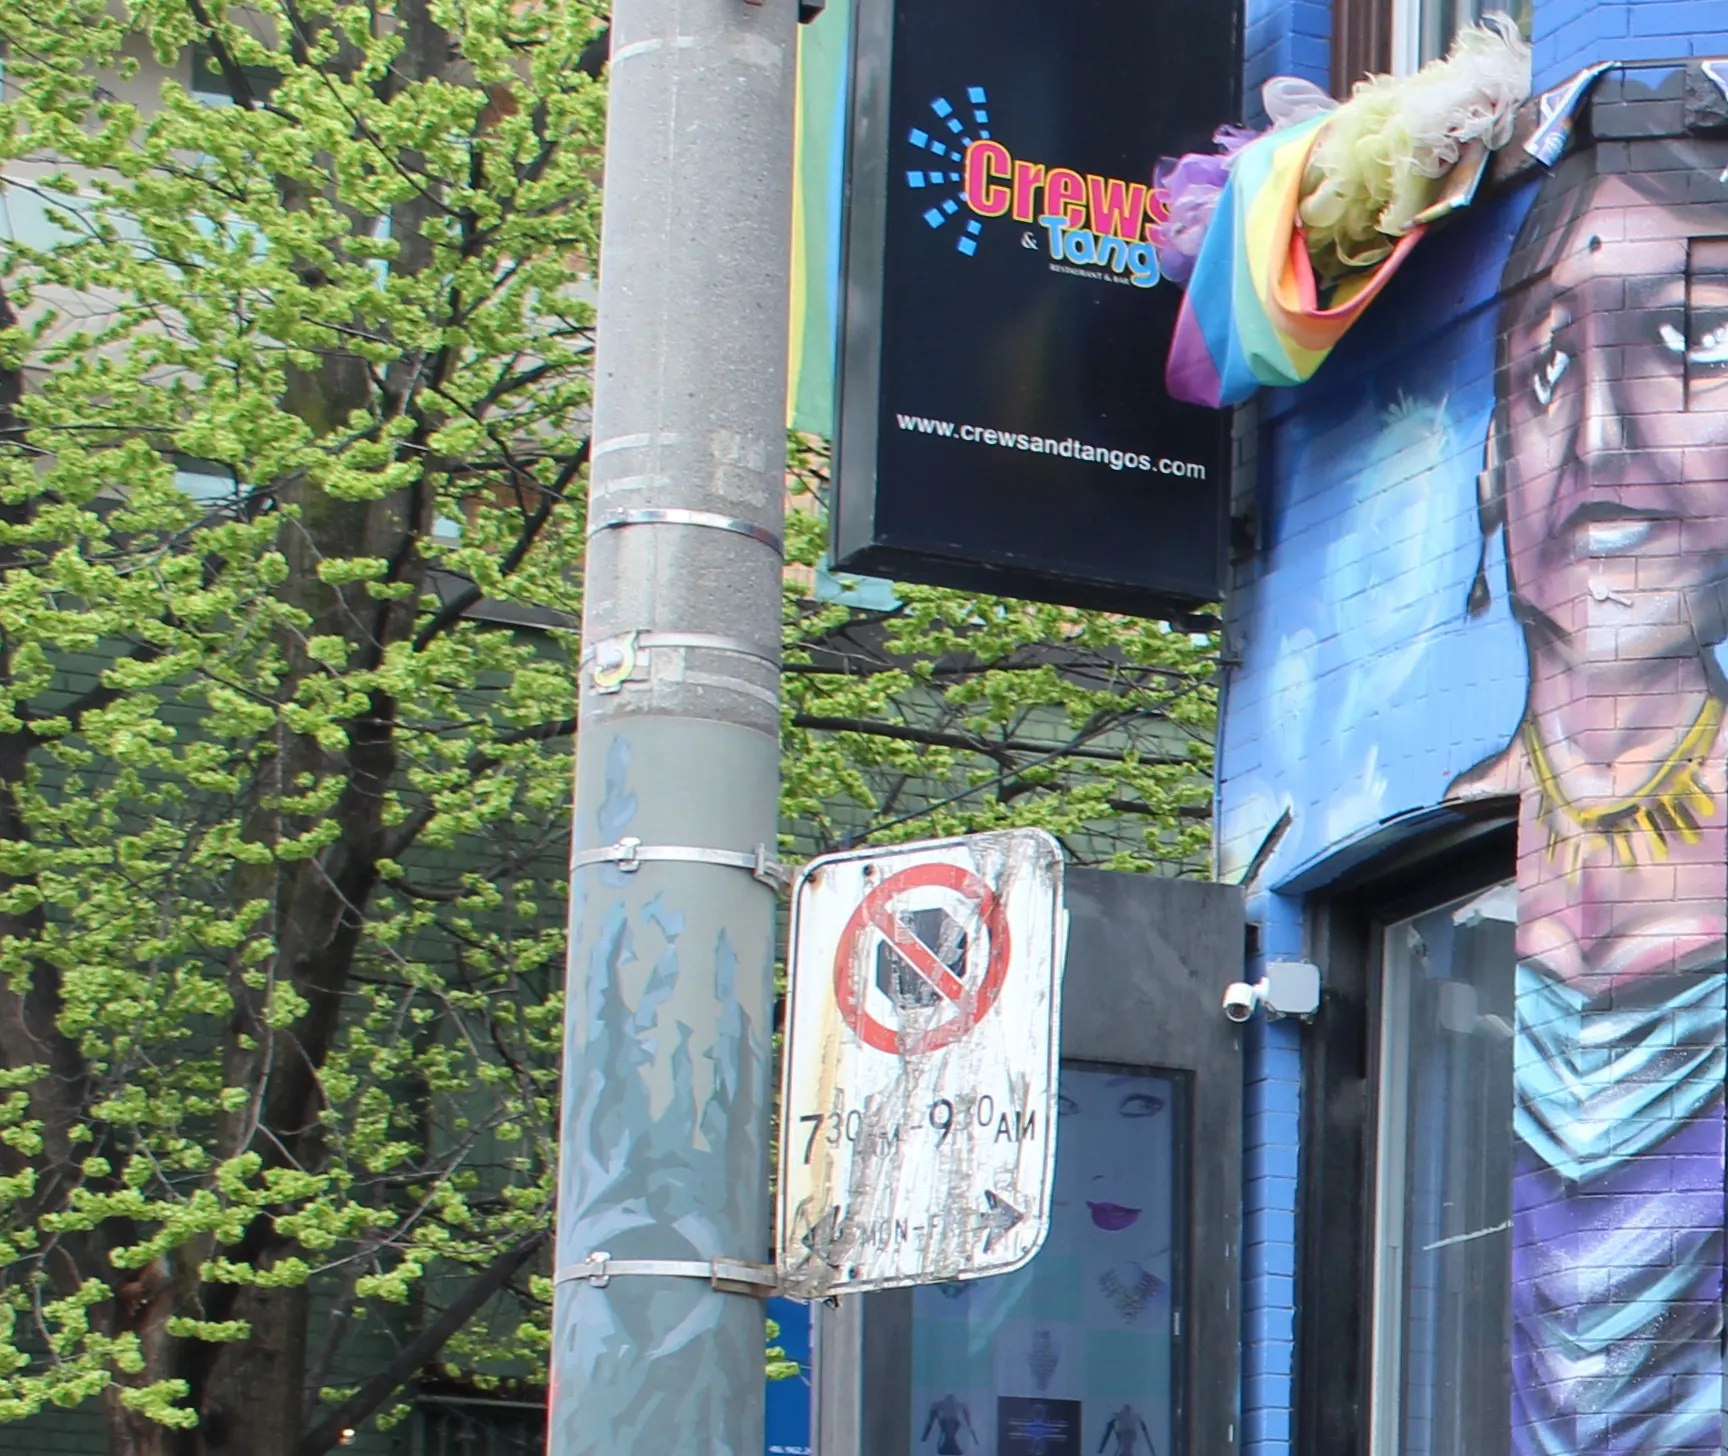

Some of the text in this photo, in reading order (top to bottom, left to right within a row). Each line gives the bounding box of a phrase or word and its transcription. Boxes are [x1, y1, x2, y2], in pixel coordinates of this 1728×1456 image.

[1020, 214, 1161, 288] & Tang
[896, 413, 1207, 480] www.crewsandtangos.com
